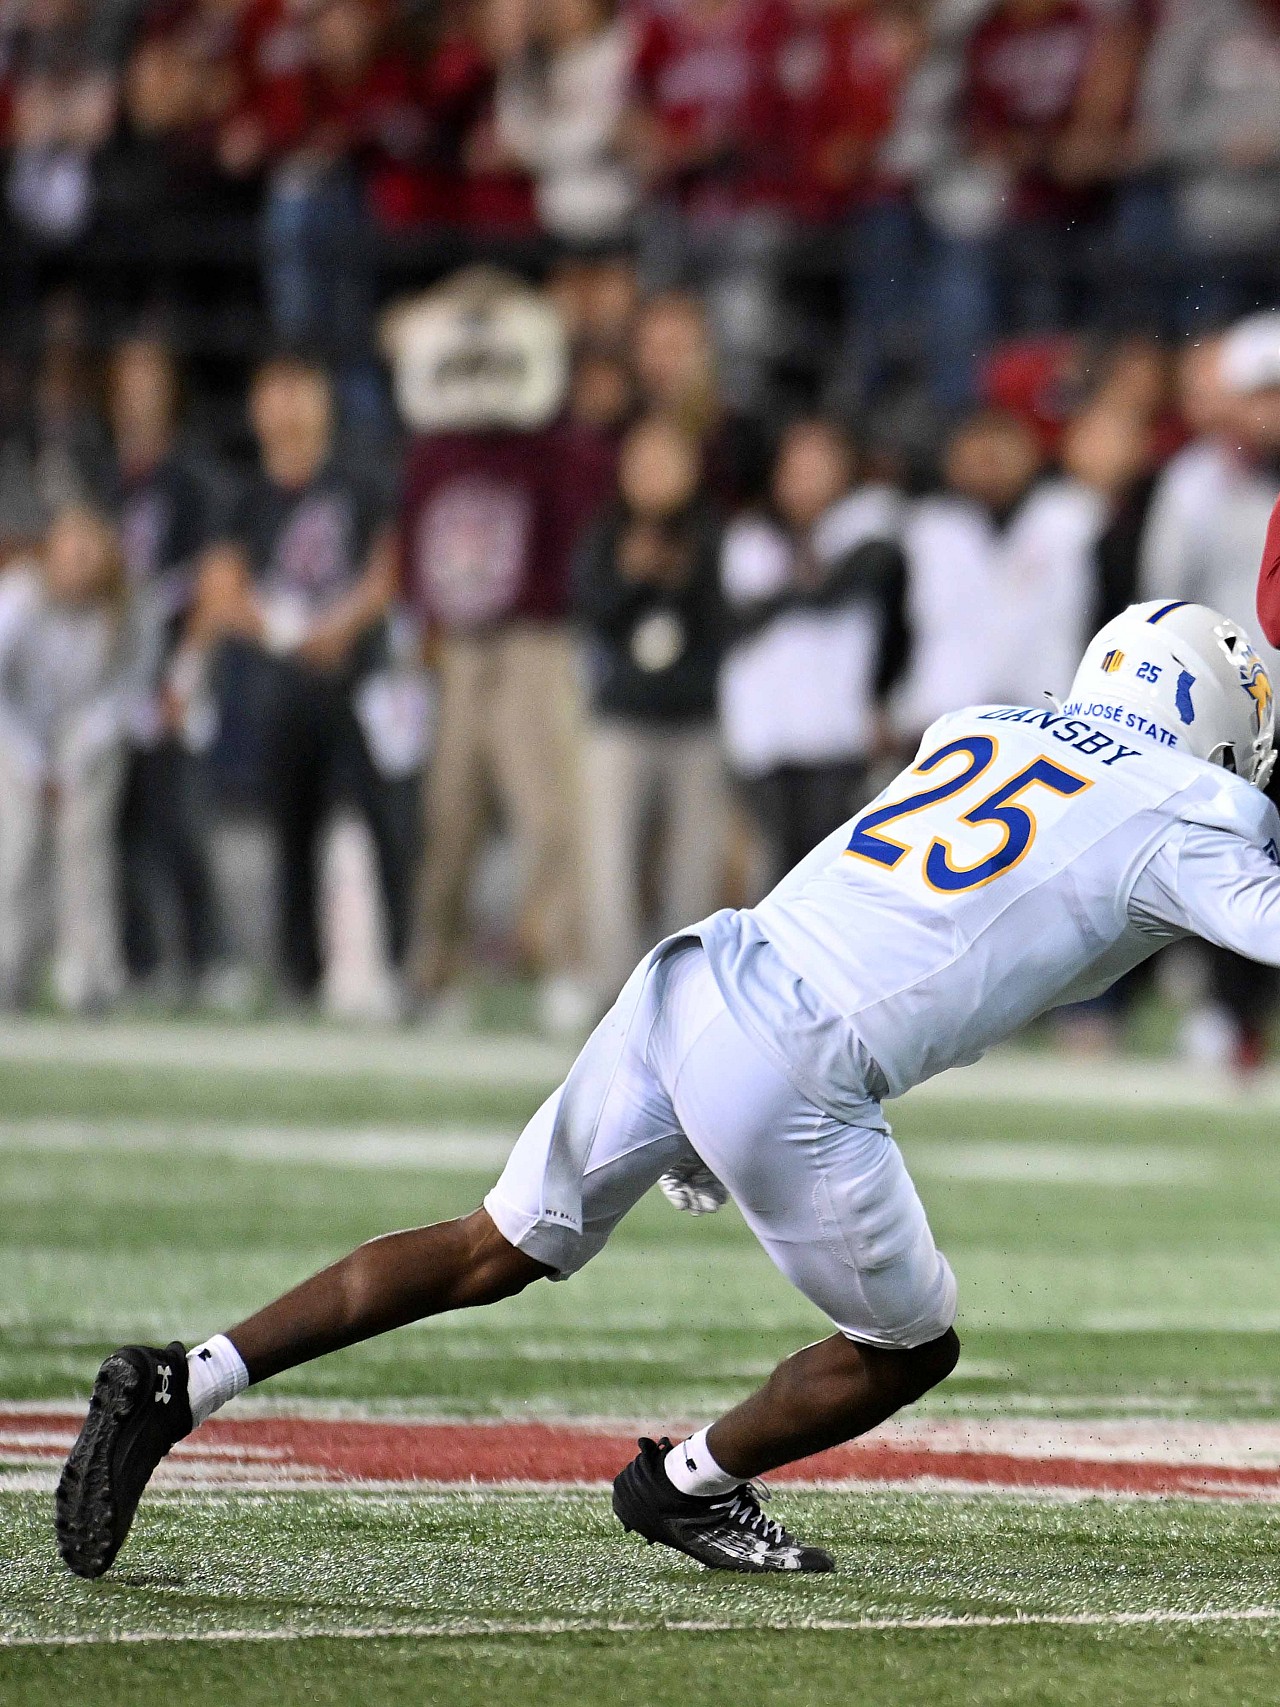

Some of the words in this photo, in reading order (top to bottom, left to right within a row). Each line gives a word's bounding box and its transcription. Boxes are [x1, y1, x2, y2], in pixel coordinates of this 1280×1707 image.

[1136, 661, 1162, 684] 25
[976, 708, 1143, 766] DANSBY
[1084, 703, 1123, 722] JOSÉ
[1125, 713, 1178, 748] STATE
[843, 734, 1095, 895] 25
